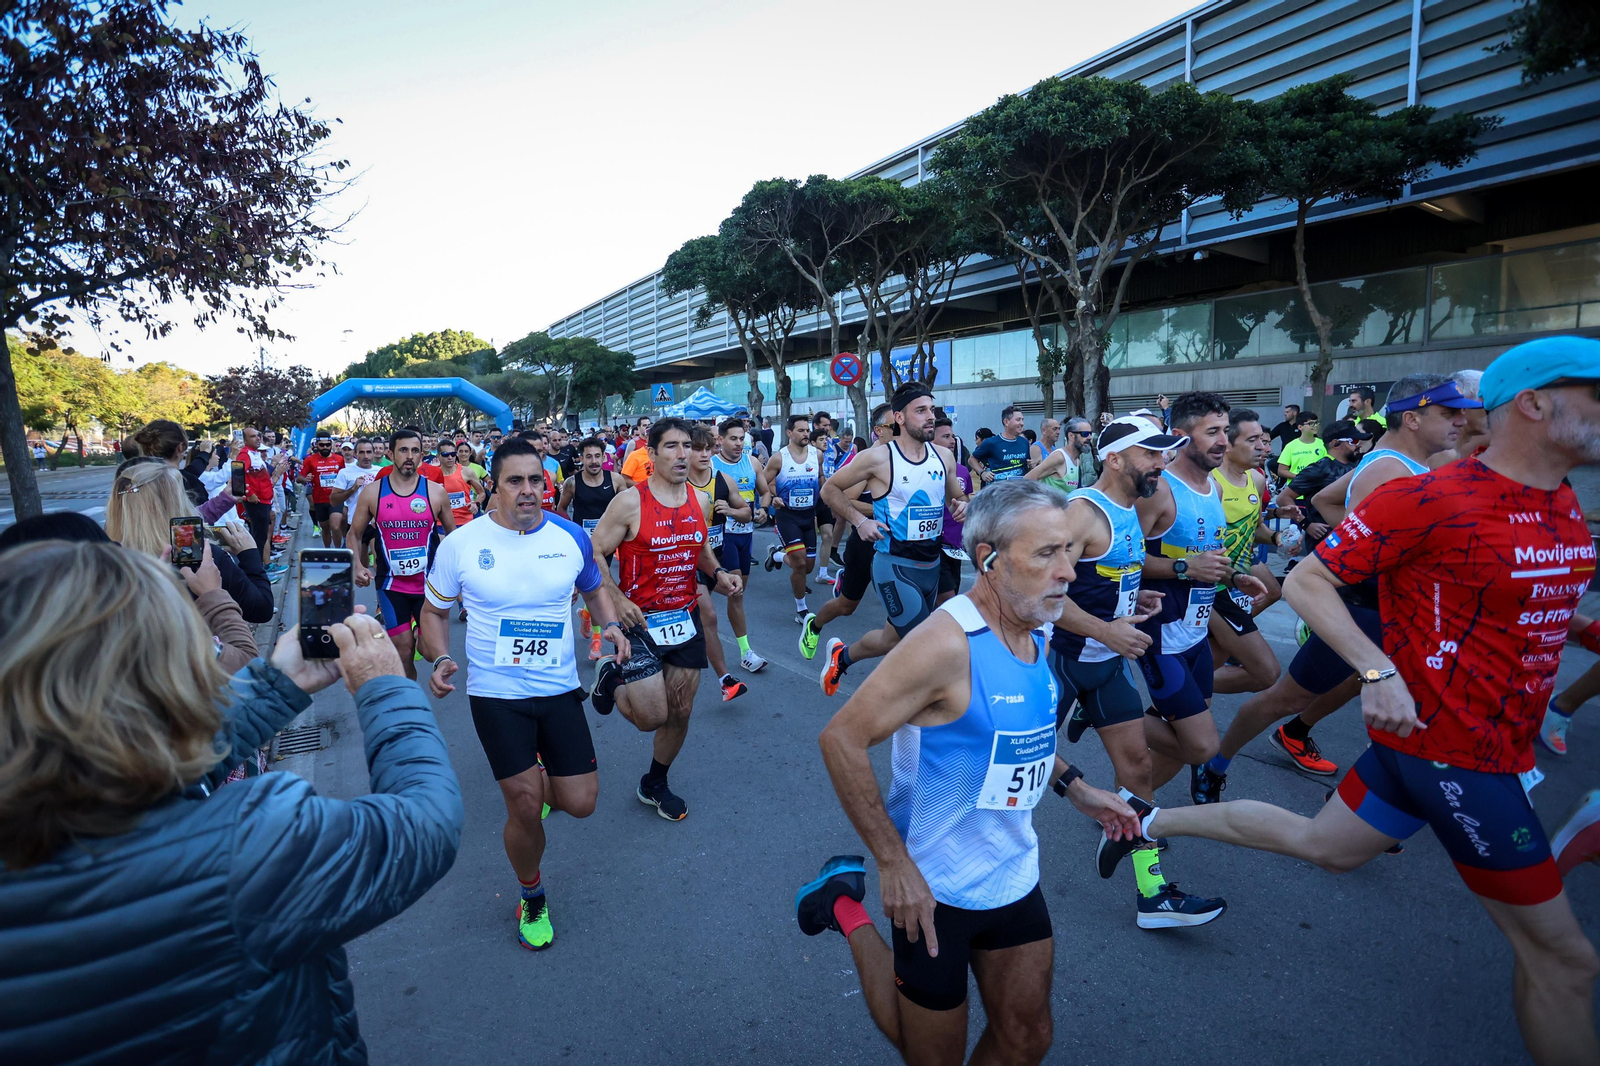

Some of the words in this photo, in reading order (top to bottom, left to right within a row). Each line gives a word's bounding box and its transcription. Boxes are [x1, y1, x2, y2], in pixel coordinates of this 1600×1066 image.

[381, 520, 429, 528] GADEIRAS
[919, 520, 938, 532] 686
[391, 531, 420, 540] SPORT
[651, 534, 694, 546] Movijerez
[1515, 544, 1593, 564] Movijerez
[399, 559, 419, 570] 549
[884, 586, 897, 613] WONG
[660, 624, 685, 639] 112
[512, 639, 548, 656] 548
[1026, 735, 1039, 744] Carrera
[1040, 730, 1054, 739] Popular
[1015, 747, 1034, 755] Ciudad
[1039, 742, 1049, 750] Jerez
[1007, 761, 1046, 793] 510
[1453, 812, 1490, 856] Carlos
